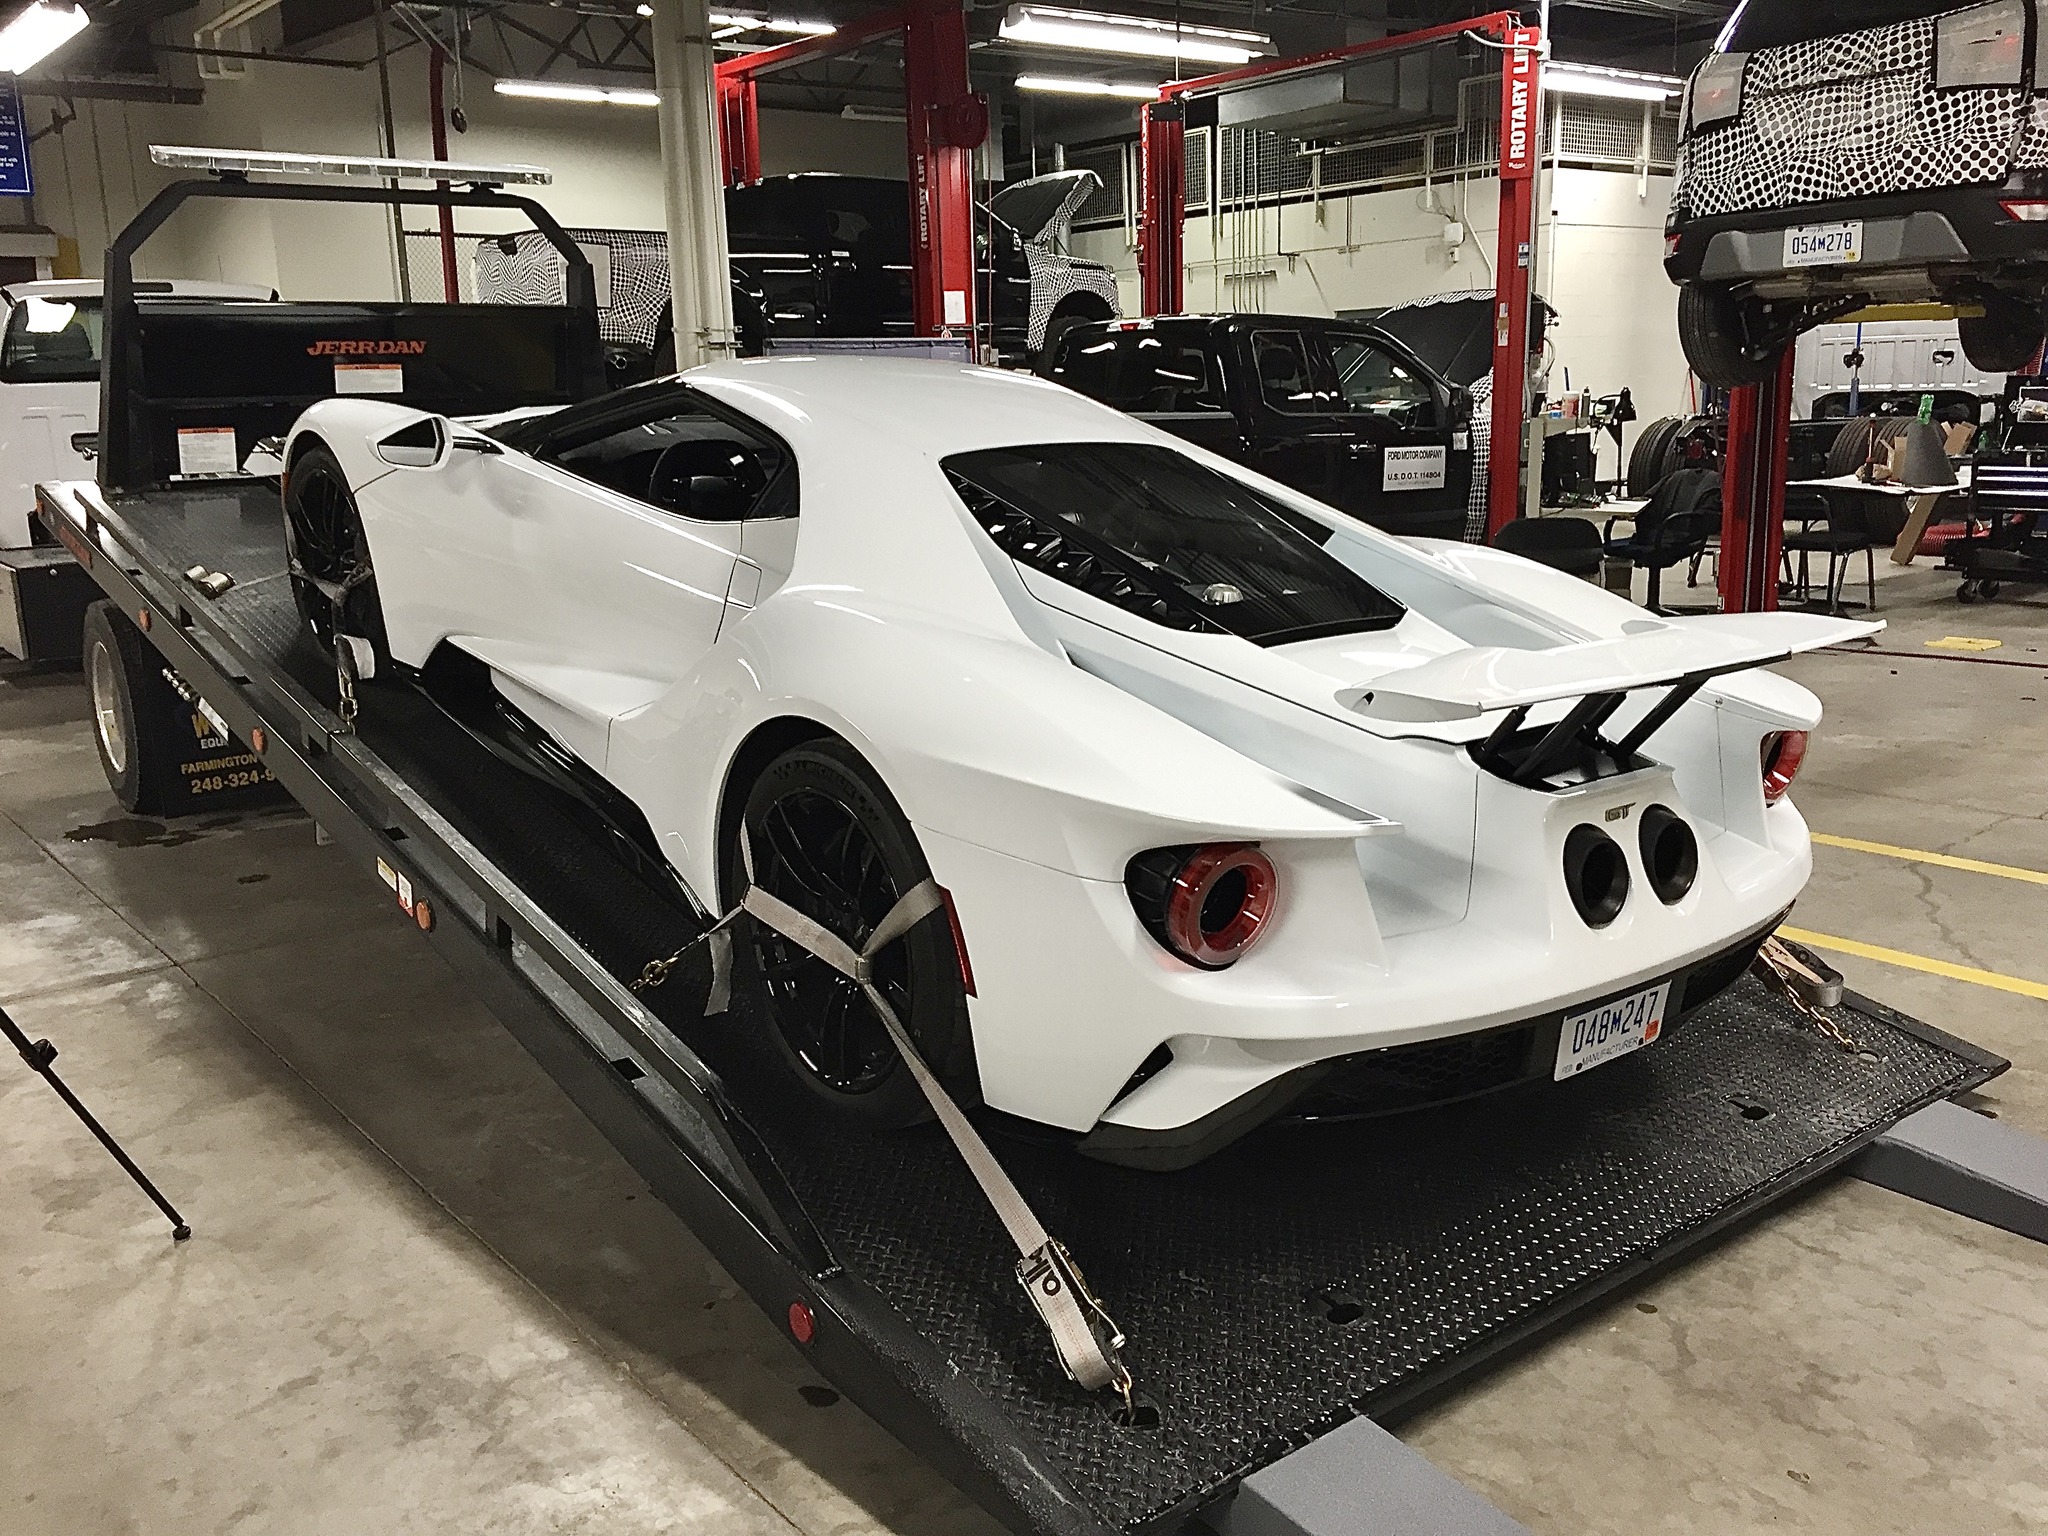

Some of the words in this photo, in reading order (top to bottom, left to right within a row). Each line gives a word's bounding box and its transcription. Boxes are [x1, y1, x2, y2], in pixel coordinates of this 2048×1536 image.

[1510, 79, 1528, 159] ROTARY
[917, 154, 925, 183] LIFT
[919, 187, 928, 242] ROTARY
[1792, 231, 1853, 255] 054M278
[1387, 451, 1401, 461] FORD
[1401, 450, 1419, 460] MOTOR
[1419, 449, 1443, 460] COMPANY
[181, 753, 258, 775] FARMINGTON
[1572, 990, 1659, 1056] 048M247
[1581, 1036, 1639, 1067] MANUFACTURER
